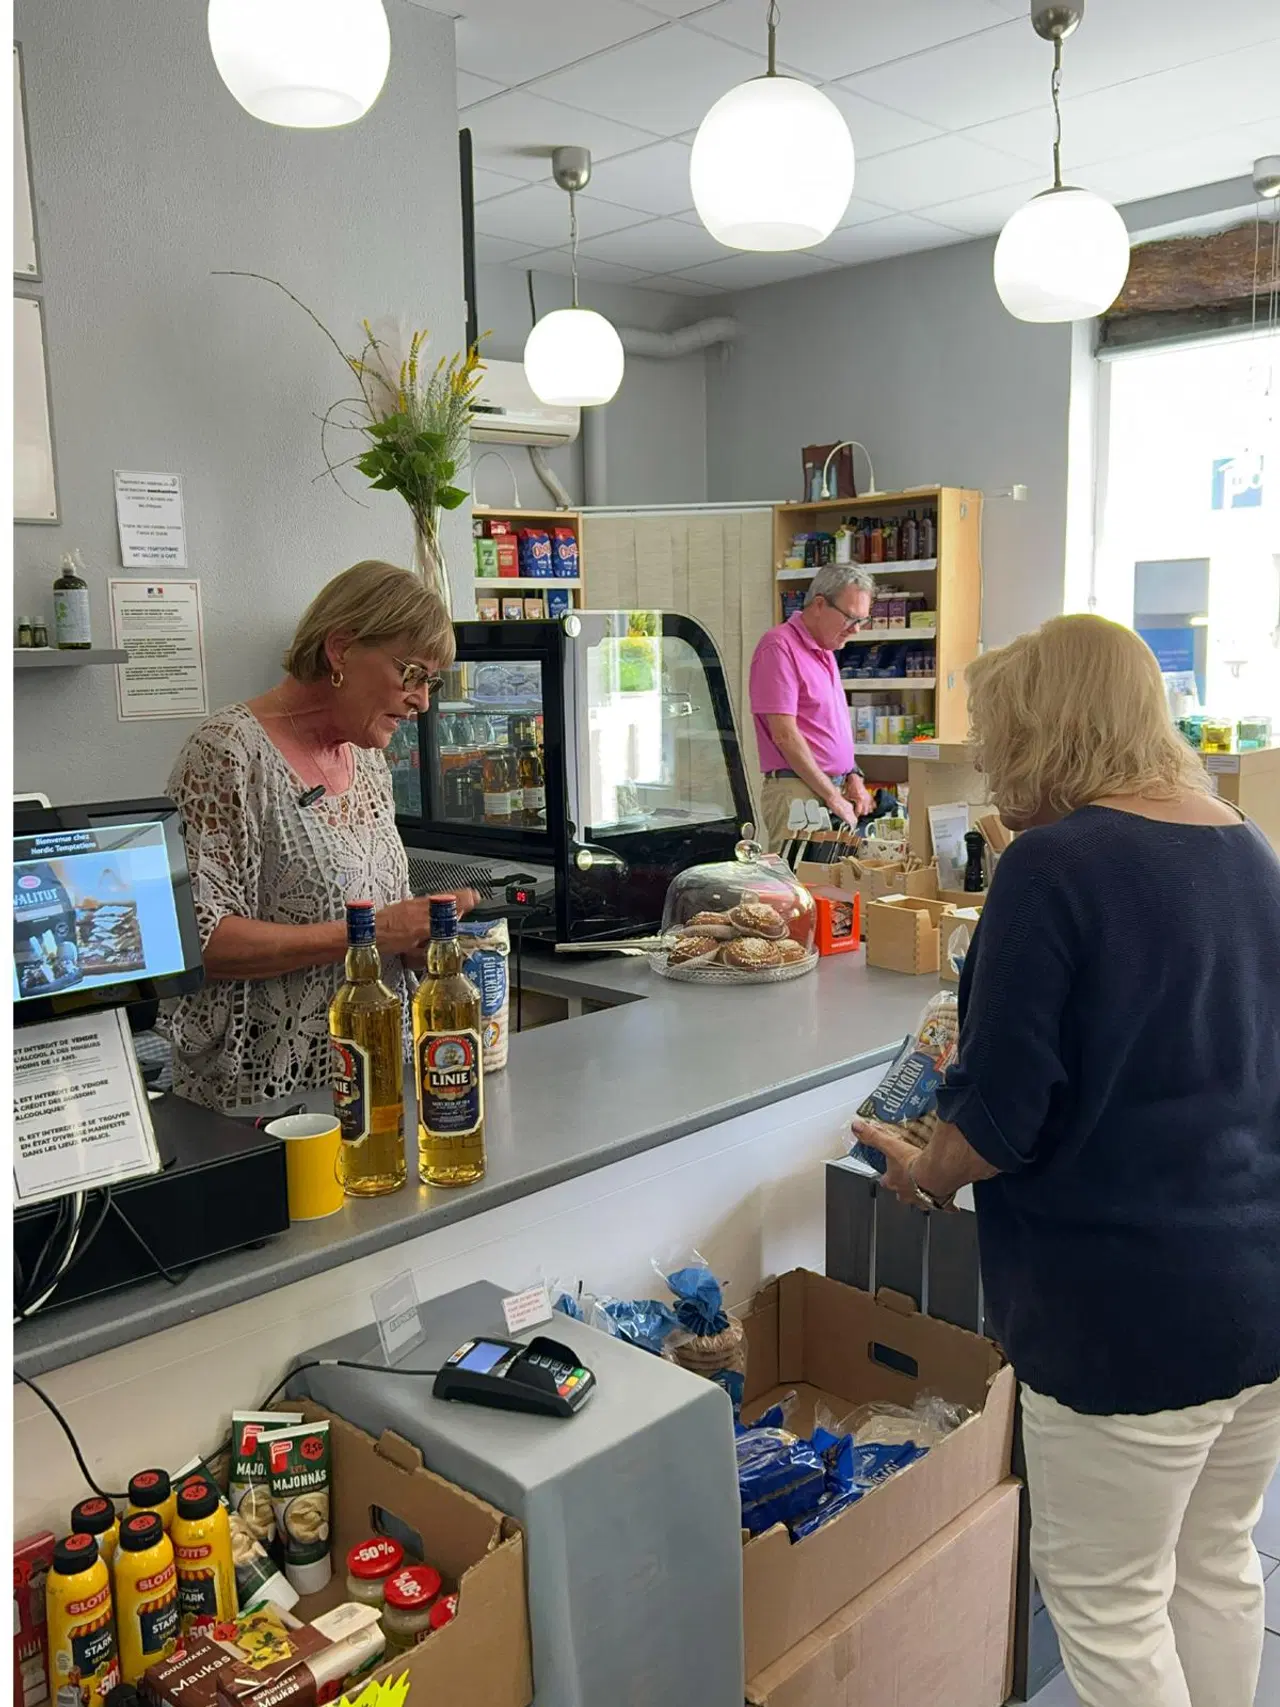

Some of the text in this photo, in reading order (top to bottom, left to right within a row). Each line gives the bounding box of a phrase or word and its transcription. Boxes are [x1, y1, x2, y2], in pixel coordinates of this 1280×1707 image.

[31, 842, 96, 855] Nordic Temptations
[35, 835, 72, 845] Bienvenue
[482, 956, 497, 1007] FULLKORN
[334, 1081, 349, 1093] NIE
[432, 1073, 468, 1086] LINIE
[883, 1059, 924, 1114] FULLKORN
[27, 1132, 41, 1140] EST
[22, 1149, 43, 1158] DANS
[45, 1145, 56, 1153] LES
[237, 1462, 266, 1475] MAJO
[273, 1469, 327, 1491] MAJONNÄS
[175, 1546, 209, 1558] OTTS
[354, 1541, 395, 1562] -50%
[139, 1563, 176, 1591] SLOTT
[70, 1585, 109, 1614] SLOTT
[181, 1592, 205, 1602] TARK
[152, 1610, 178, 1634] STARK
[84, 1635, 112, 1658] STARK
[170, 1655, 231, 1696] Maukas
[257, 1683, 300, 1707] Maukas
